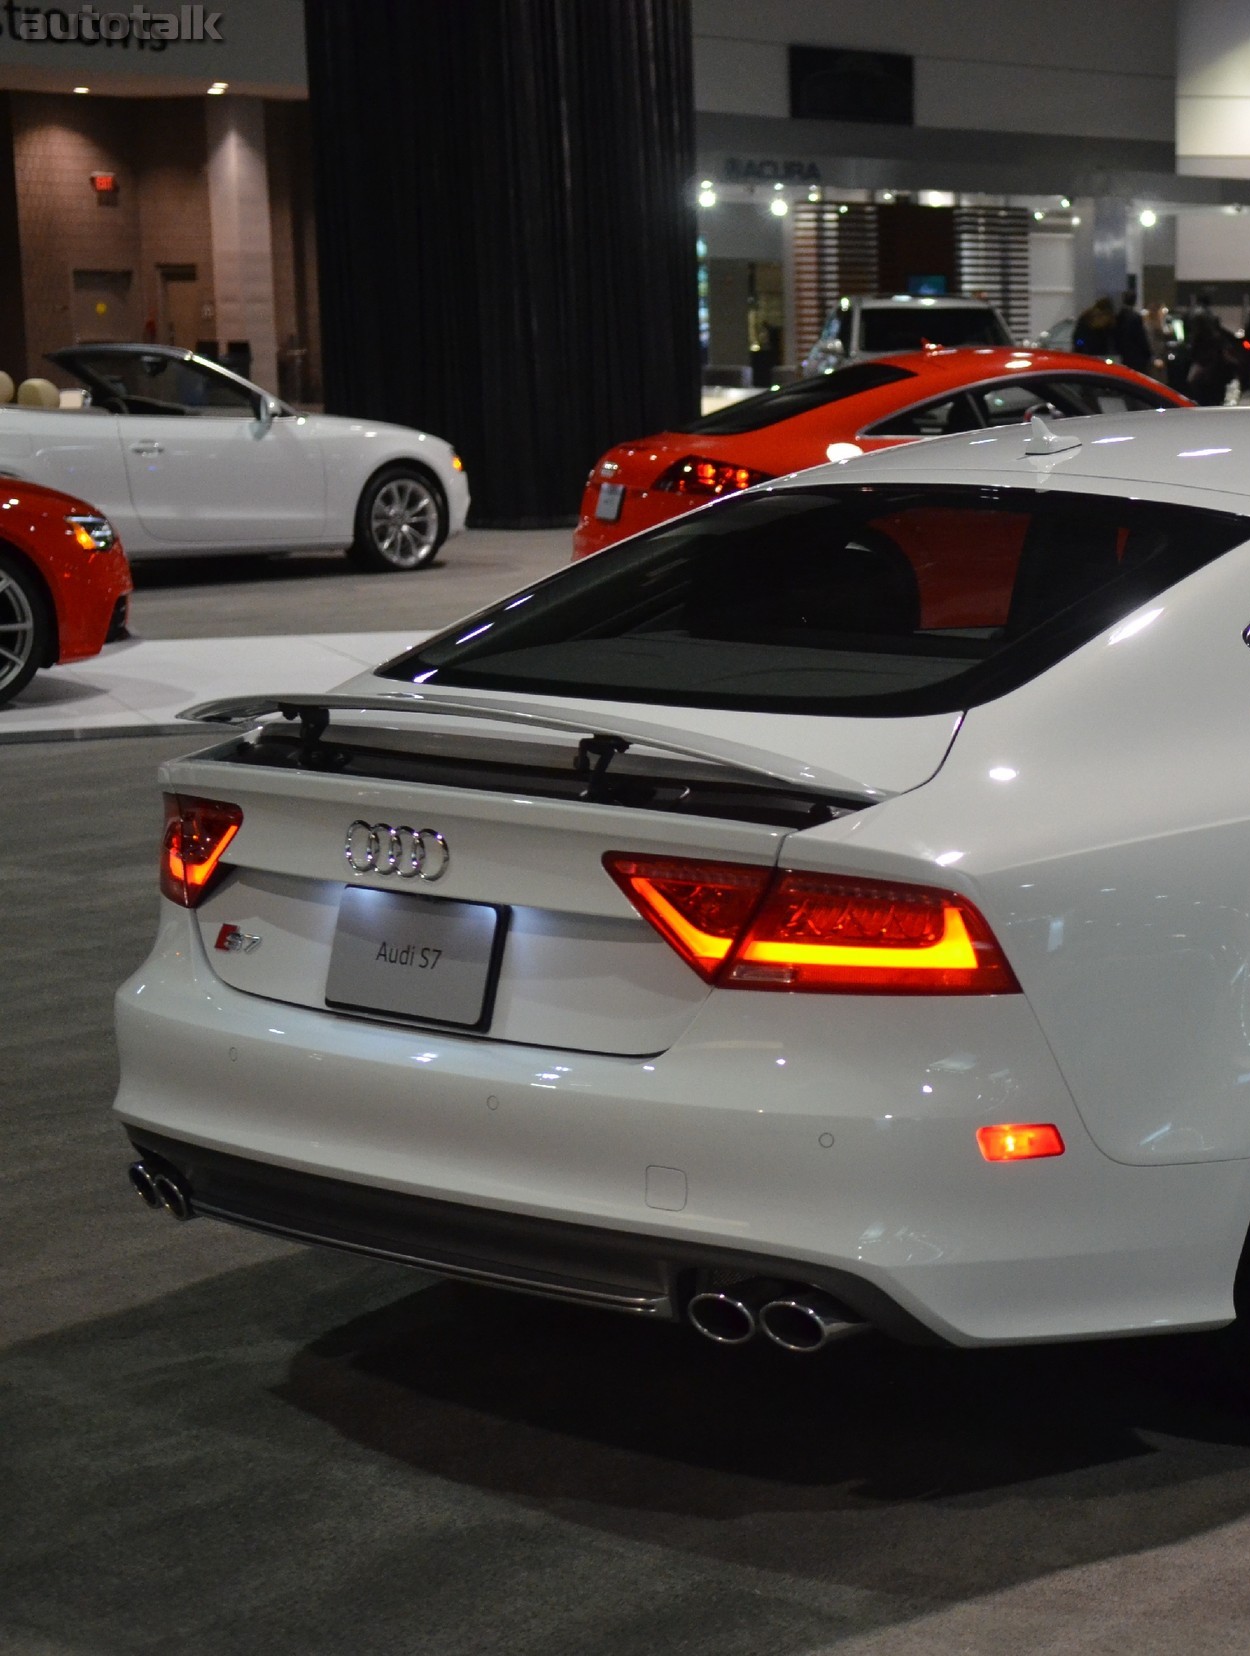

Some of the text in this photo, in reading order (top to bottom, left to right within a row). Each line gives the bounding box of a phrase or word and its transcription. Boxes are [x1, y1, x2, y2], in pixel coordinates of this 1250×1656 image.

[743, 159, 822, 180] ACURA
[375, 941, 442, 970] Audi S7
